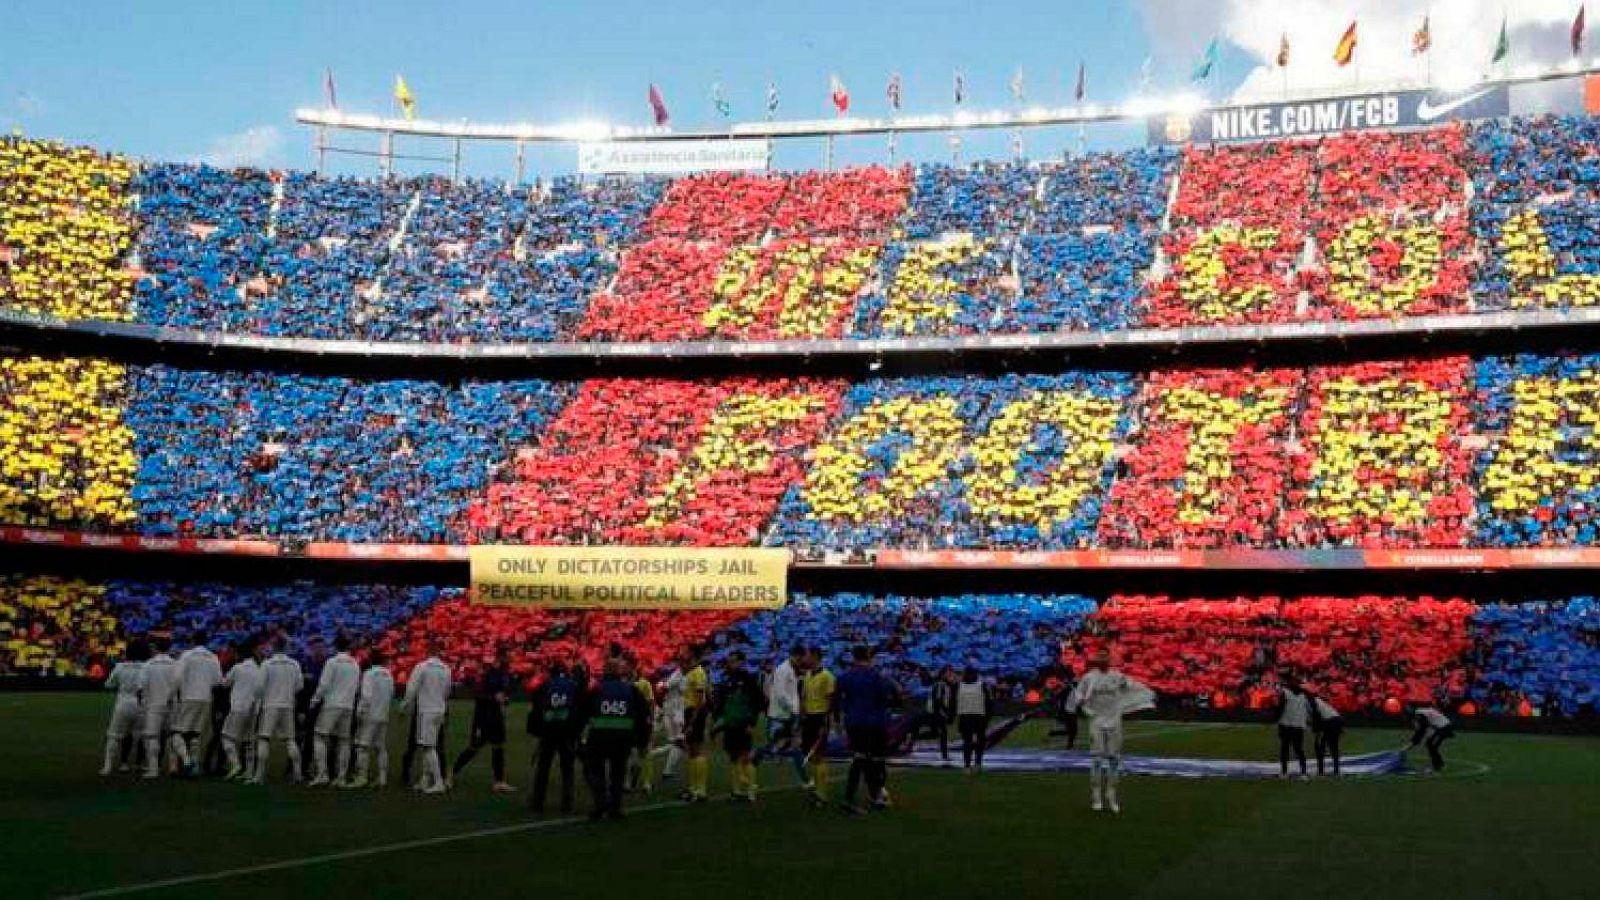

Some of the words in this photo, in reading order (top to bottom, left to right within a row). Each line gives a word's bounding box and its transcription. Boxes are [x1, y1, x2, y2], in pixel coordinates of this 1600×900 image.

[1212, 97, 1399, 139] NIKE.COM/FCB
[499, 559, 547, 574] ONLY
[557, 559, 709, 575] DICTATORSHIPS
[718, 559, 757, 575] JAIL
[478, 583, 577, 600] PEACEFUL
[583, 584, 681, 601] POLITICAL
[690, 585, 779, 601] LEADERS
